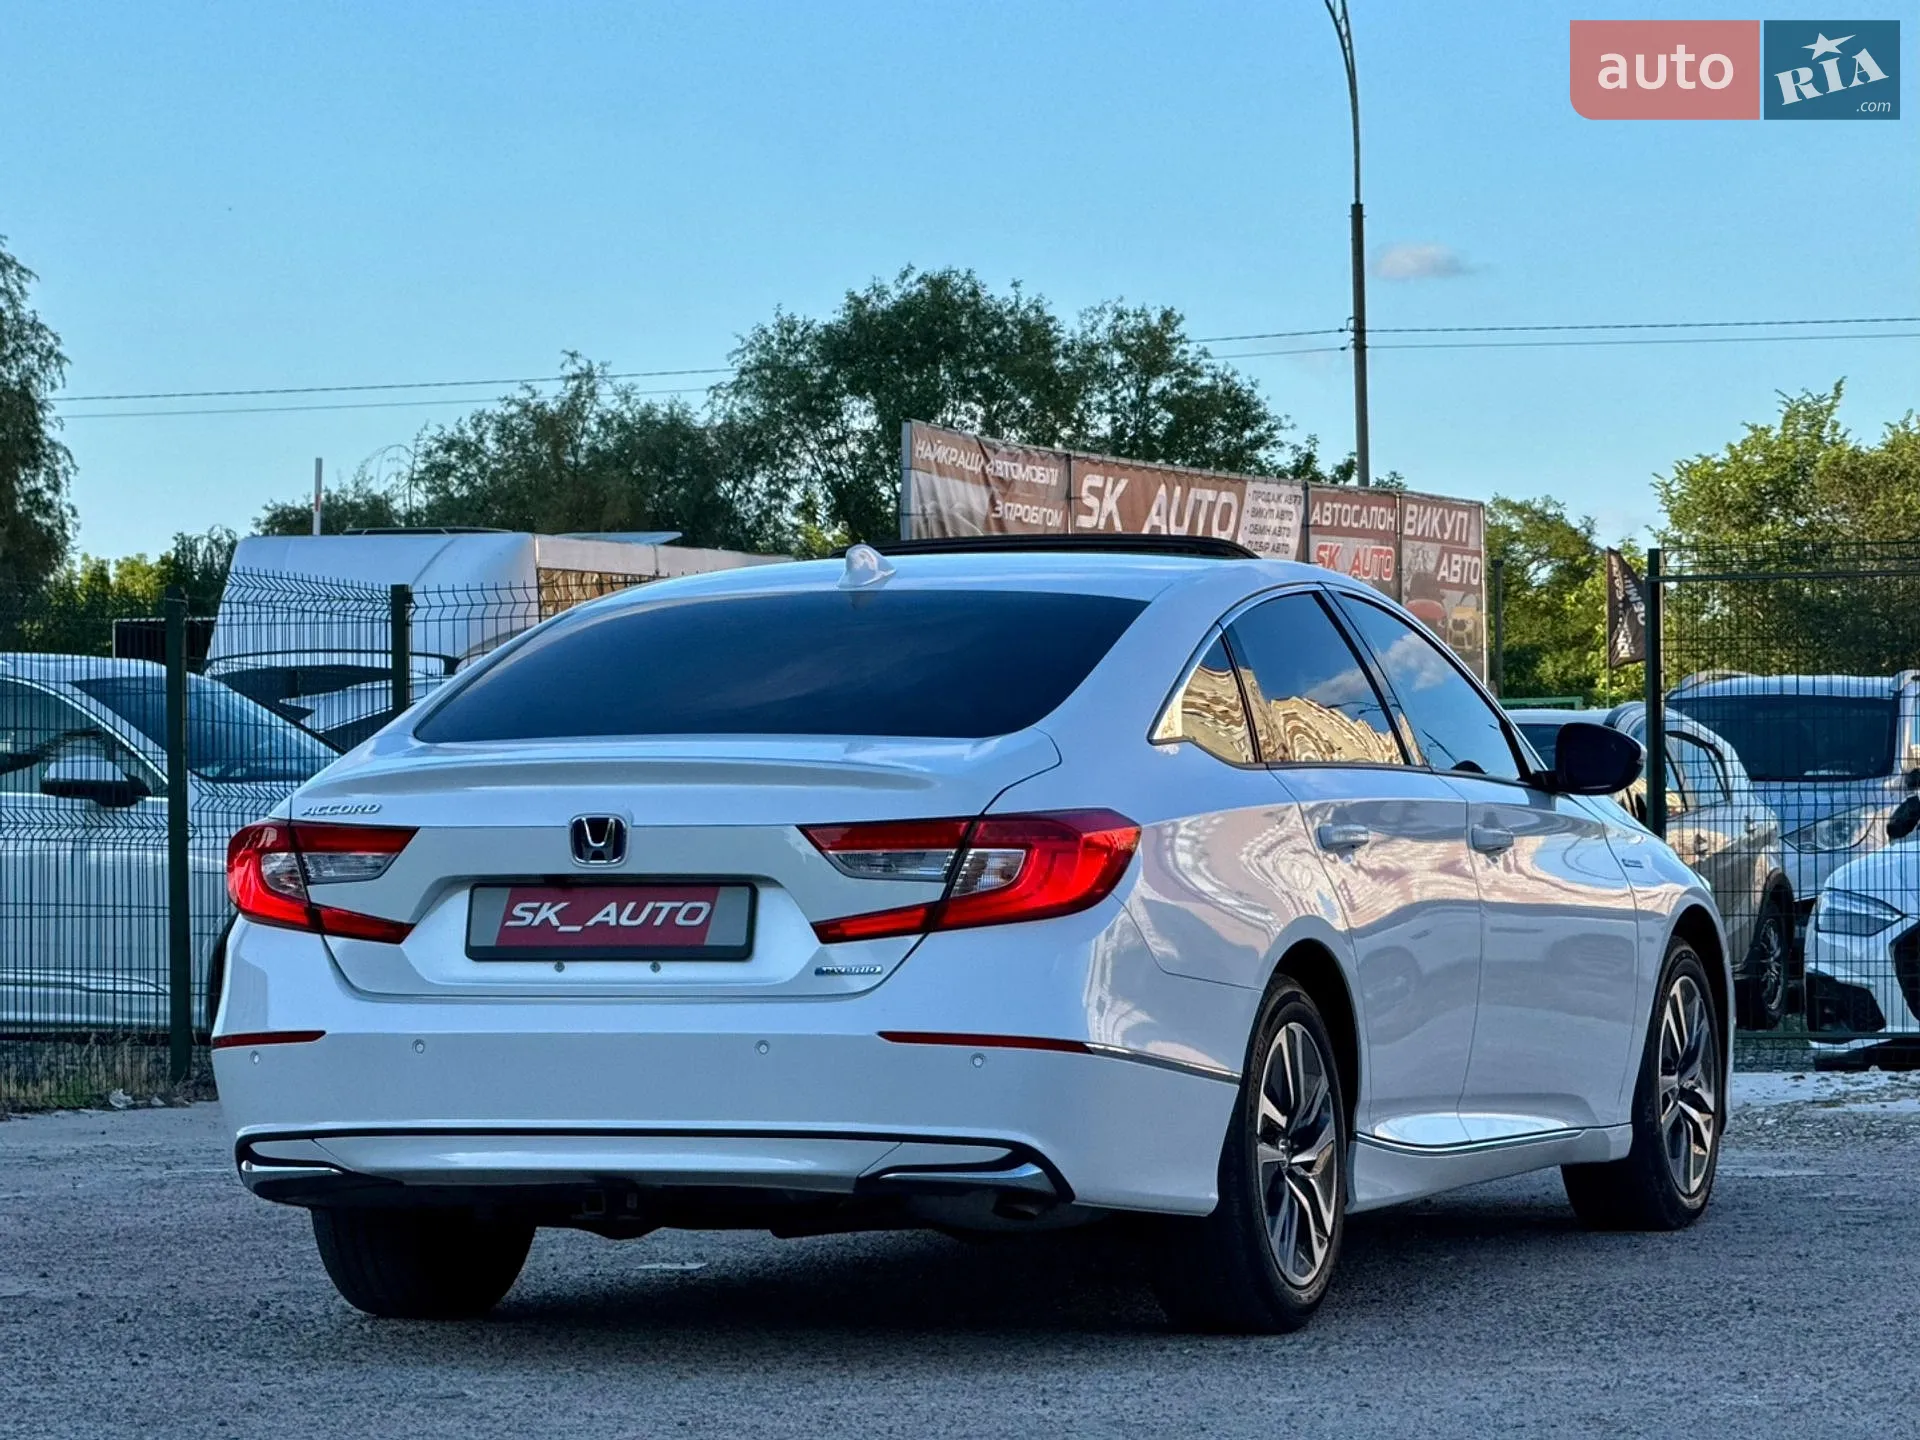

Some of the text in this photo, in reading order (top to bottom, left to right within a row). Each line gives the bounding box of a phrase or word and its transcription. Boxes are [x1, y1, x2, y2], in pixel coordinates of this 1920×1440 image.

[915, 439, 984, 474] НАЙКРАЩІ
[1075, 474, 1239, 543] SK AUTO
[1310, 501, 1396, 532] АВТОСАЛОН
[1403, 503, 1470, 542] ВИКУП
[1316, 542, 1395, 581] SK AUTO
[1436, 552, 1482, 586] АВТО
[301, 803, 383, 817] ACCORD
[505, 902, 711, 932] SK_AUTO
